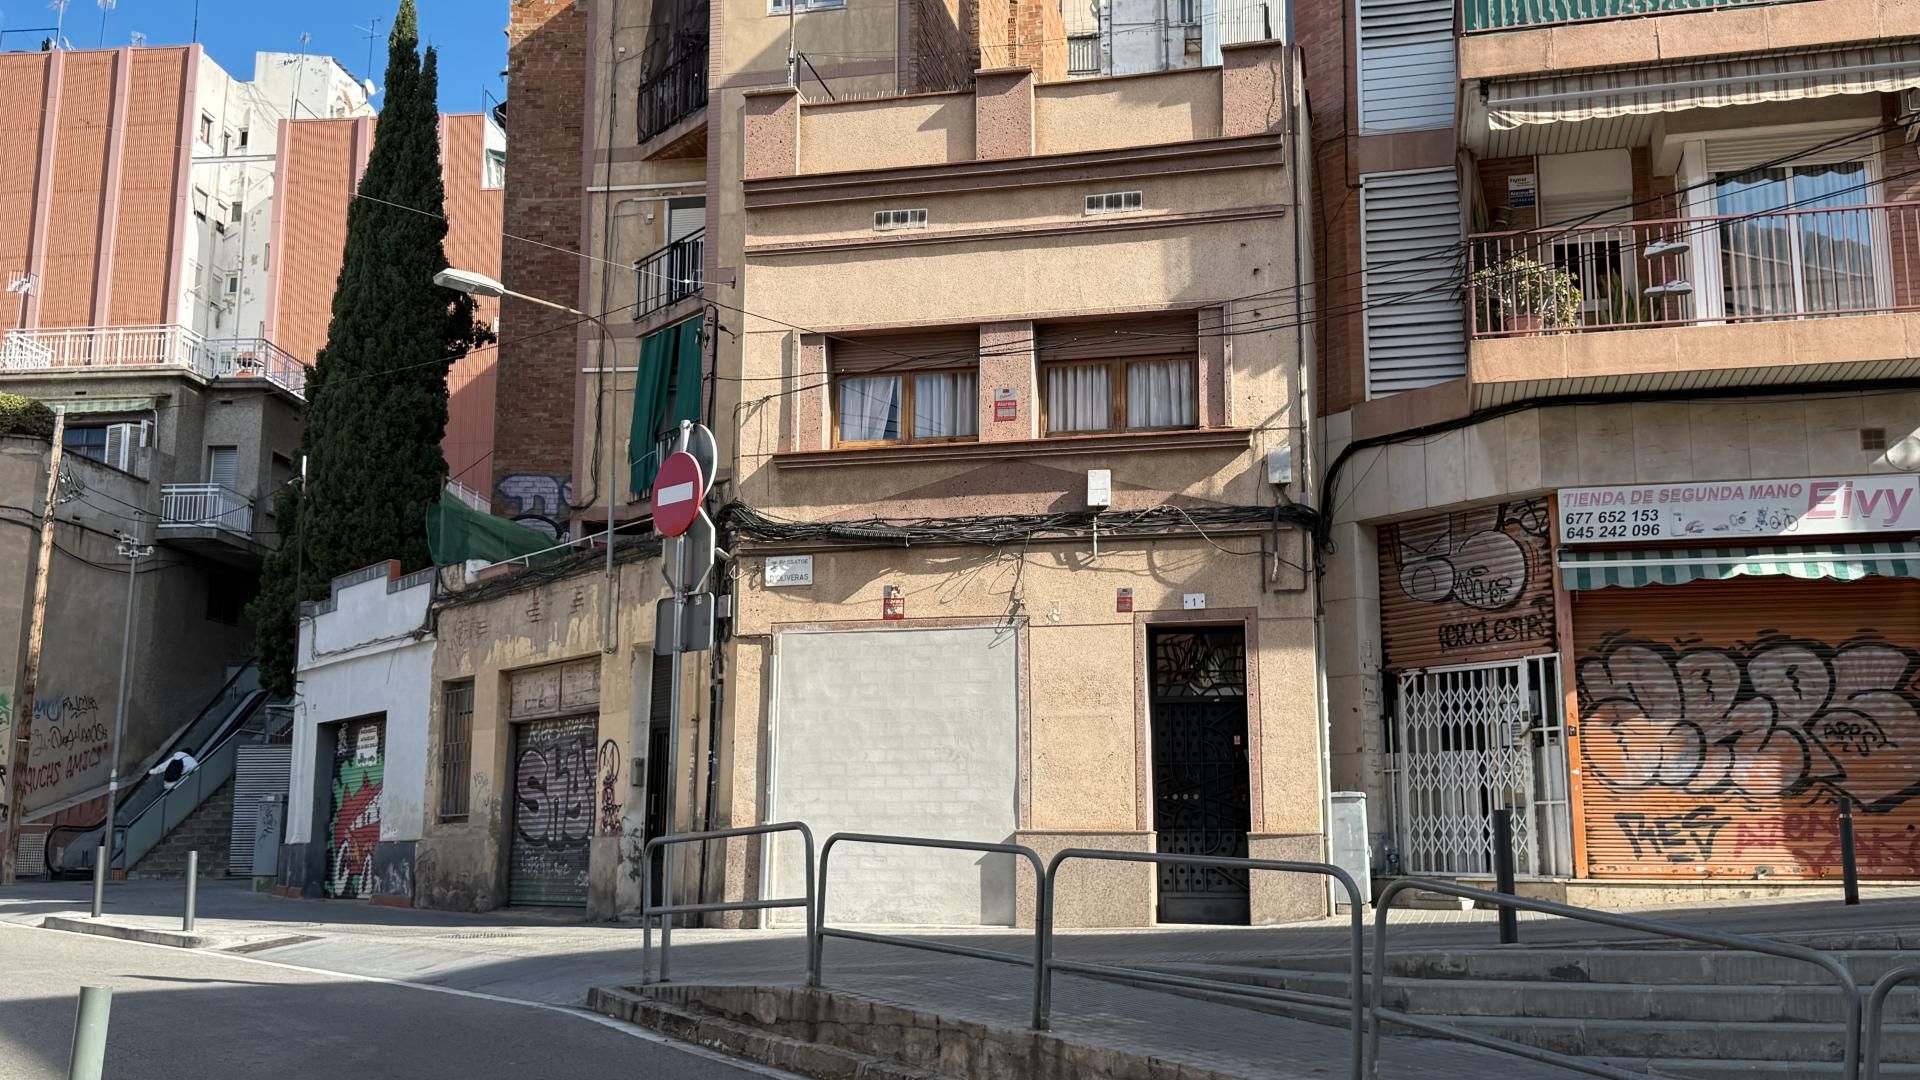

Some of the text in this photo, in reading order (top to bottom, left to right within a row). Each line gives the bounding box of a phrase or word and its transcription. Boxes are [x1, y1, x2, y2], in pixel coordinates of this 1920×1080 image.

[1563, 482, 1803, 508] TIENDA DE SEGUNDA MANO
[1565, 509, 1659, 525] 677 652 153
[1566, 523, 1660, 539] 645 242 096
